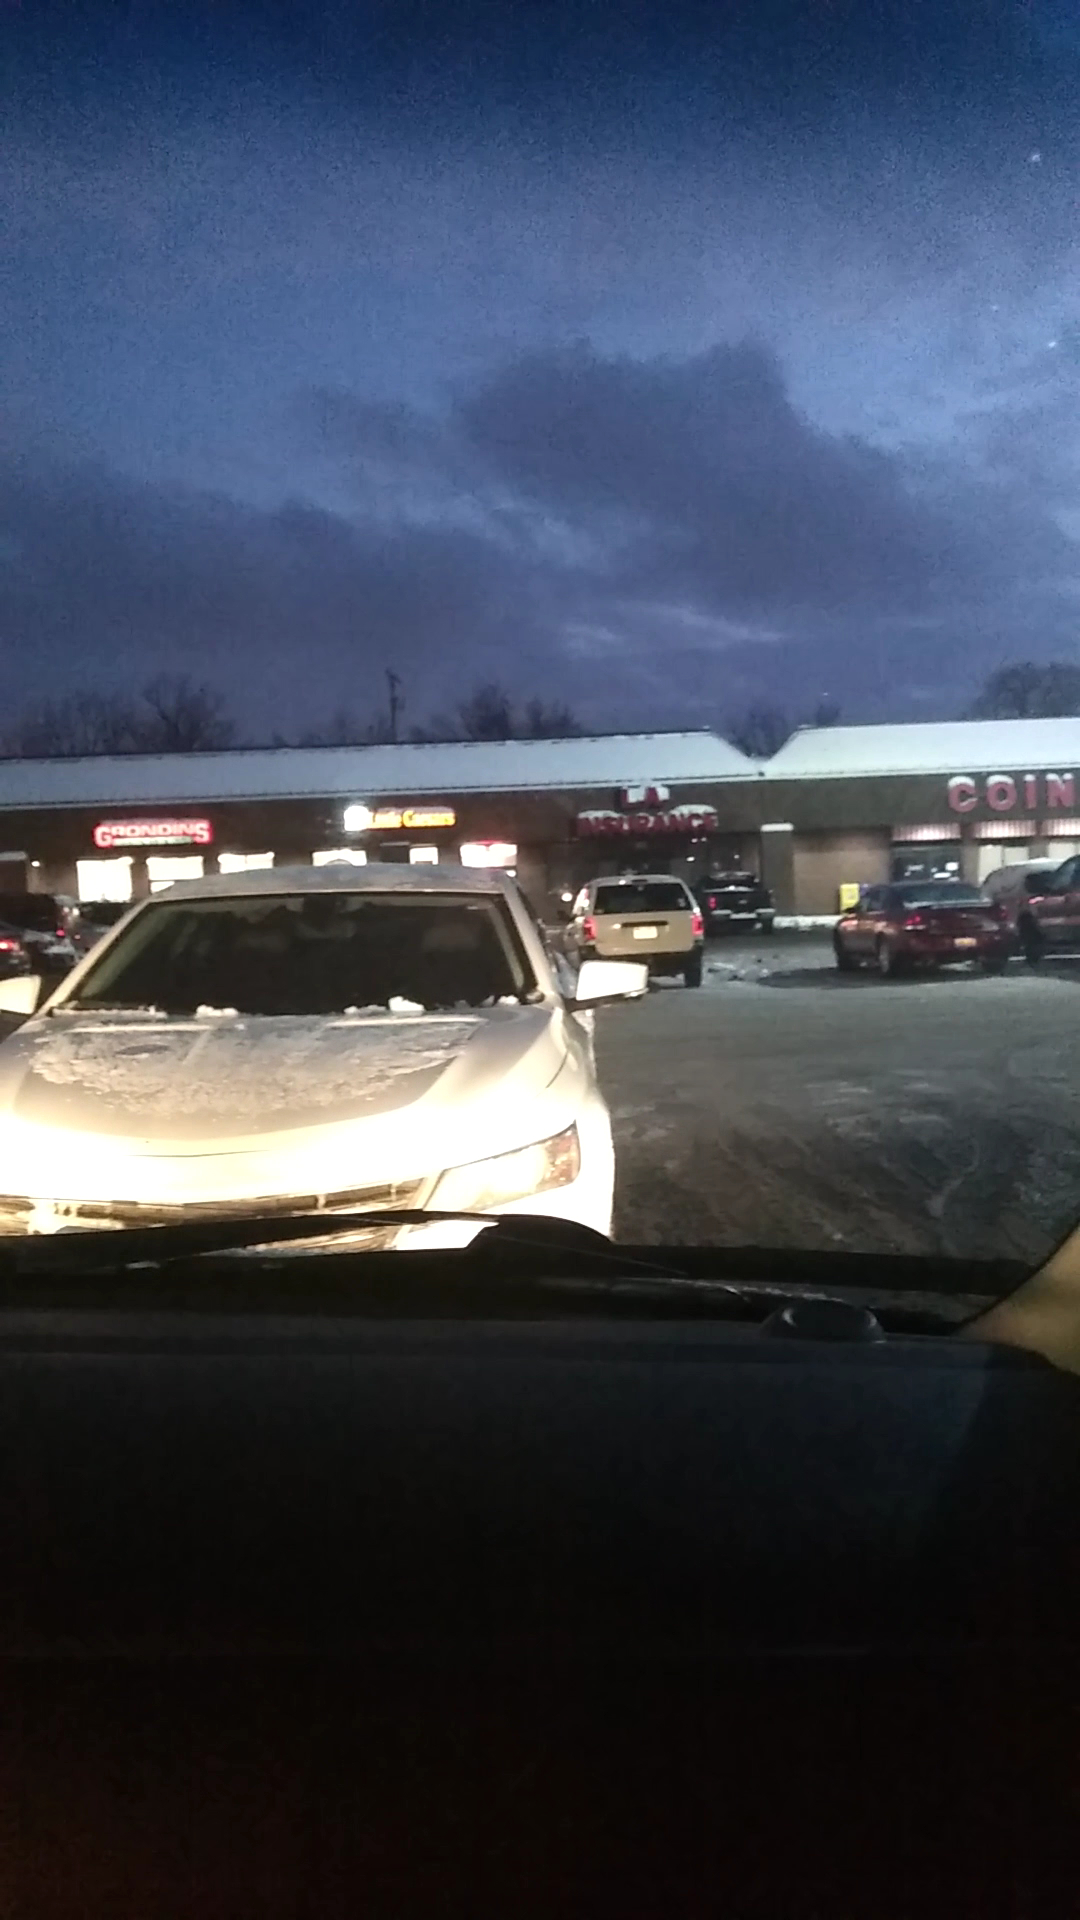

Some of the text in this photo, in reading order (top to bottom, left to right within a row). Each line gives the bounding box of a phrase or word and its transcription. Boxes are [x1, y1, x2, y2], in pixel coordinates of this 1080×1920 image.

[946, 774, 1075, 812] COIN
[94, 821, 211, 847] GRONDINS
[576, 804, 719, 835] INSURANCE
